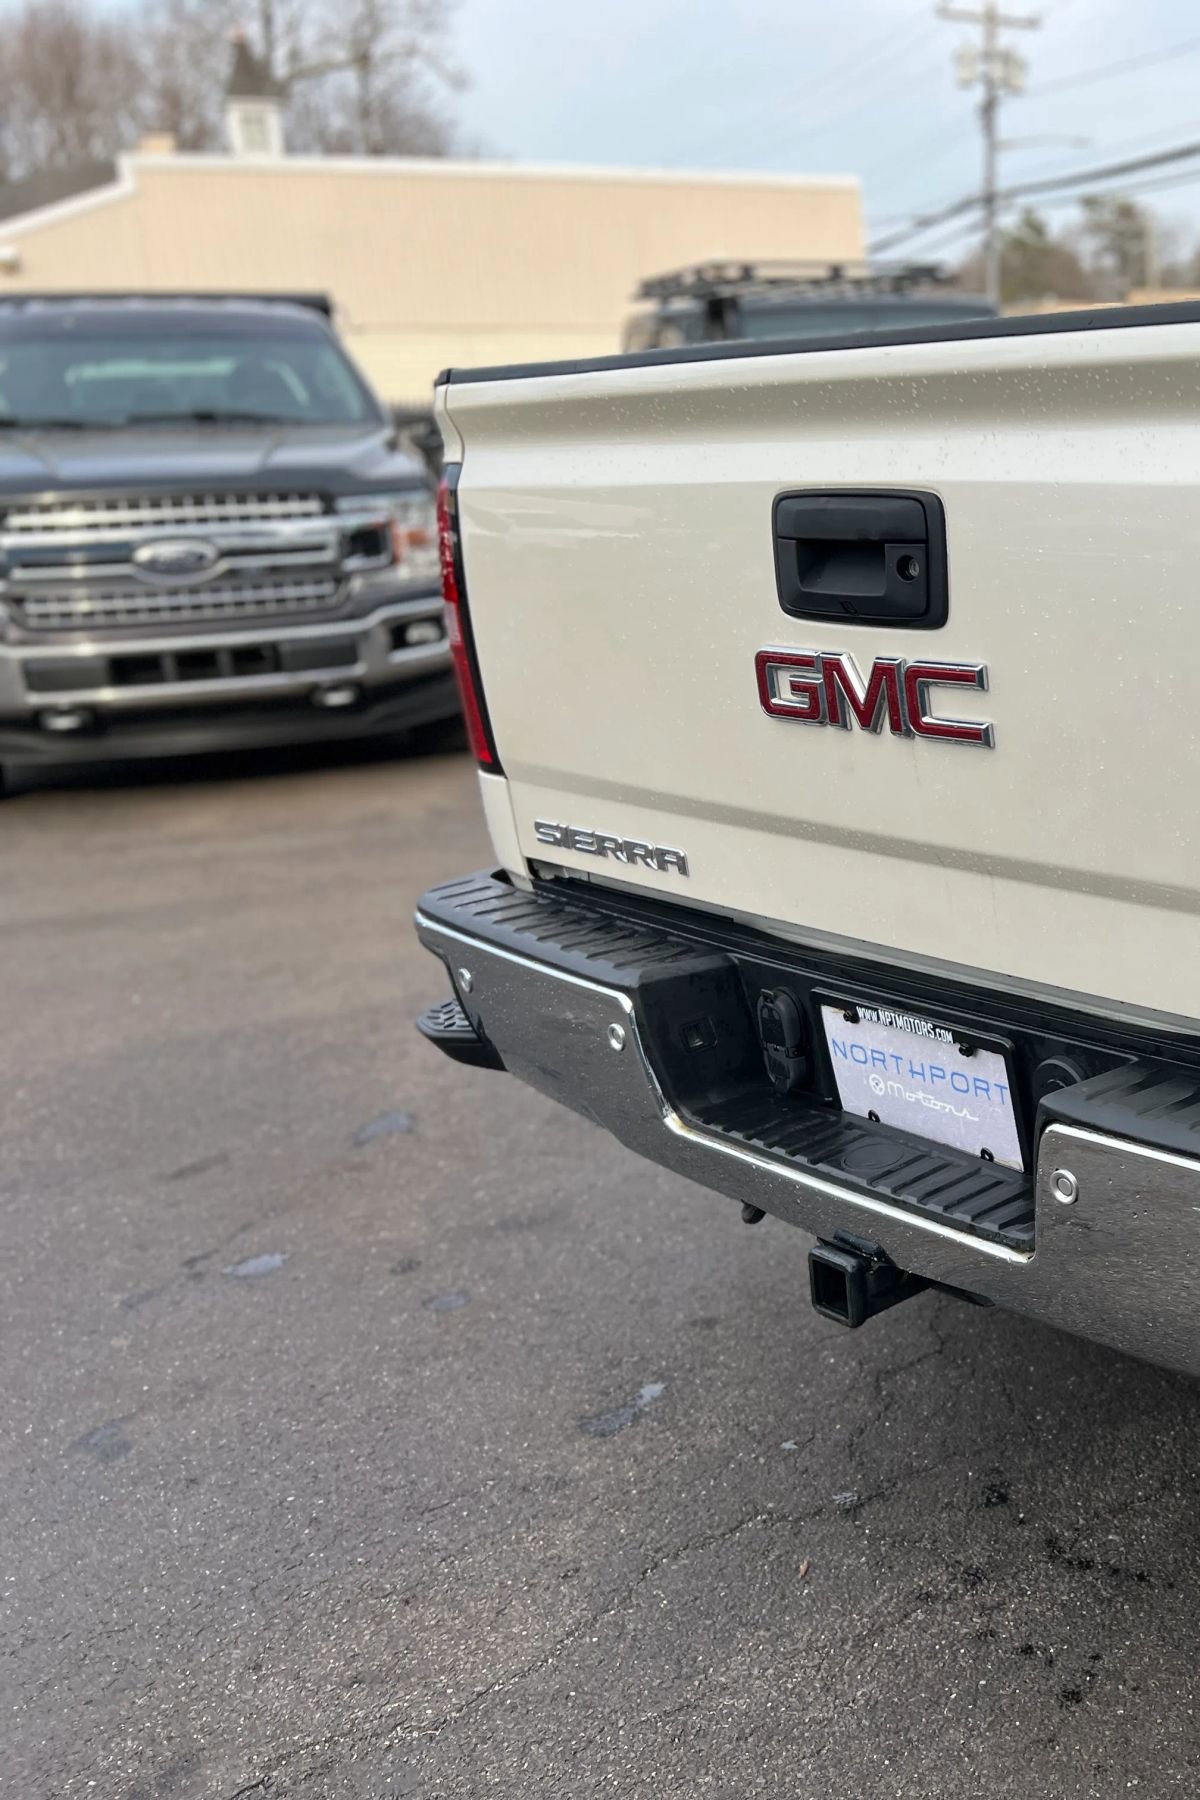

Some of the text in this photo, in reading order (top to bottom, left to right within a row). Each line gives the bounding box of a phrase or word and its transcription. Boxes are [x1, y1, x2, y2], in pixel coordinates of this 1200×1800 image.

[755, 644, 995, 749] GMC
[534, 819, 691, 878] SIERRA
[856, 1006, 953, 1044] WWW.NPTMOTORS.COM
[831, 1038, 1009, 1105] NORTHPORT
